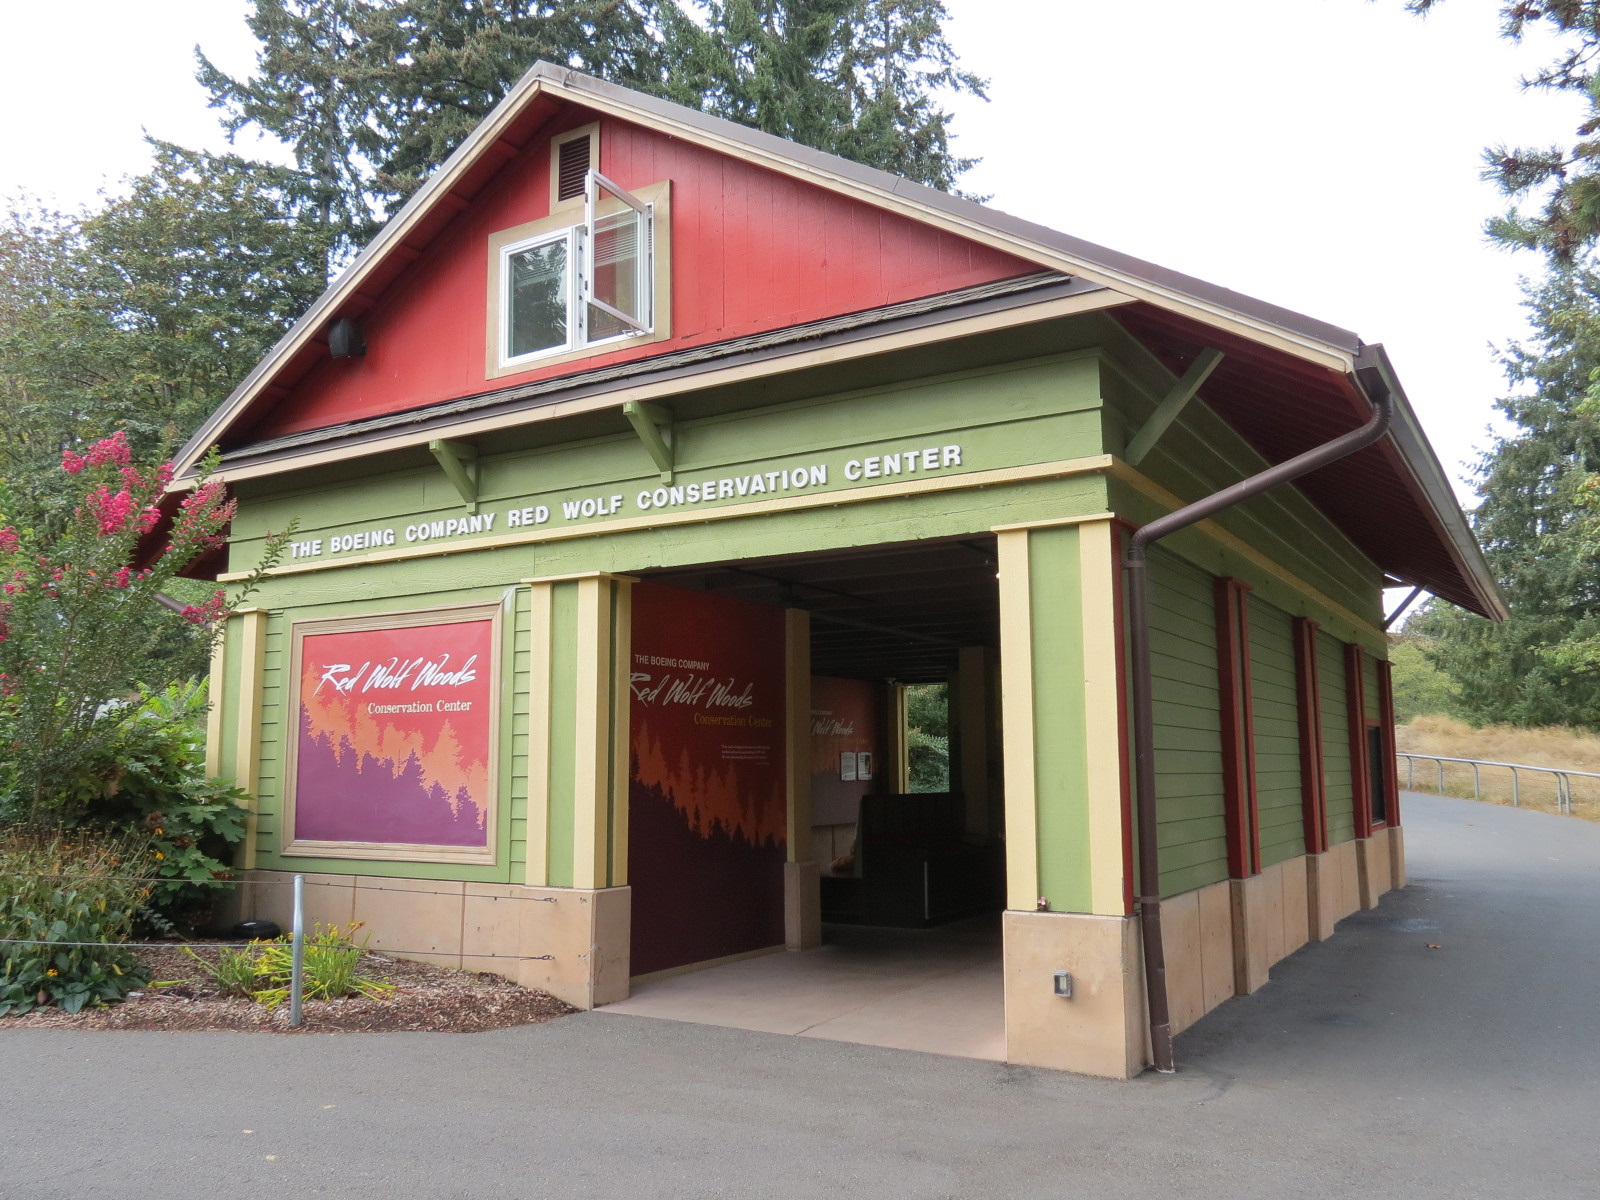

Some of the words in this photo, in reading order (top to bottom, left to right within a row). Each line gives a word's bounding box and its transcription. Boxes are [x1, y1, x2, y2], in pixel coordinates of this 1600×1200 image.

[290, 540, 322, 558] THE
[330, 529, 396, 553] BOEING
[405, 513, 496, 542] COMPANY
[508, 505, 550, 527] RED
[563, 495, 624, 520] WOLF
[637, 464, 828, 510] CONSERVATION
[844, 445, 963, 481] CENTER
[313, 661, 371, 698] Red
[362, 657, 424, 693] Wolf
[411, 653, 478, 691] Woods
[635, 654, 650, 665] THE
[650, 656, 677, 668] BOEING
[678, 659, 710, 671] COMPANY
[630, 671, 670, 708] Red
[663, 674, 715, 706] Wolf
[705, 677, 753, 709] Woods
[367, 700, 433, 714] Conservation
[436, 699, 473, 712] Center
[694, 712, 746, 727] Conservation
[748, 716, 774, 728] Center
